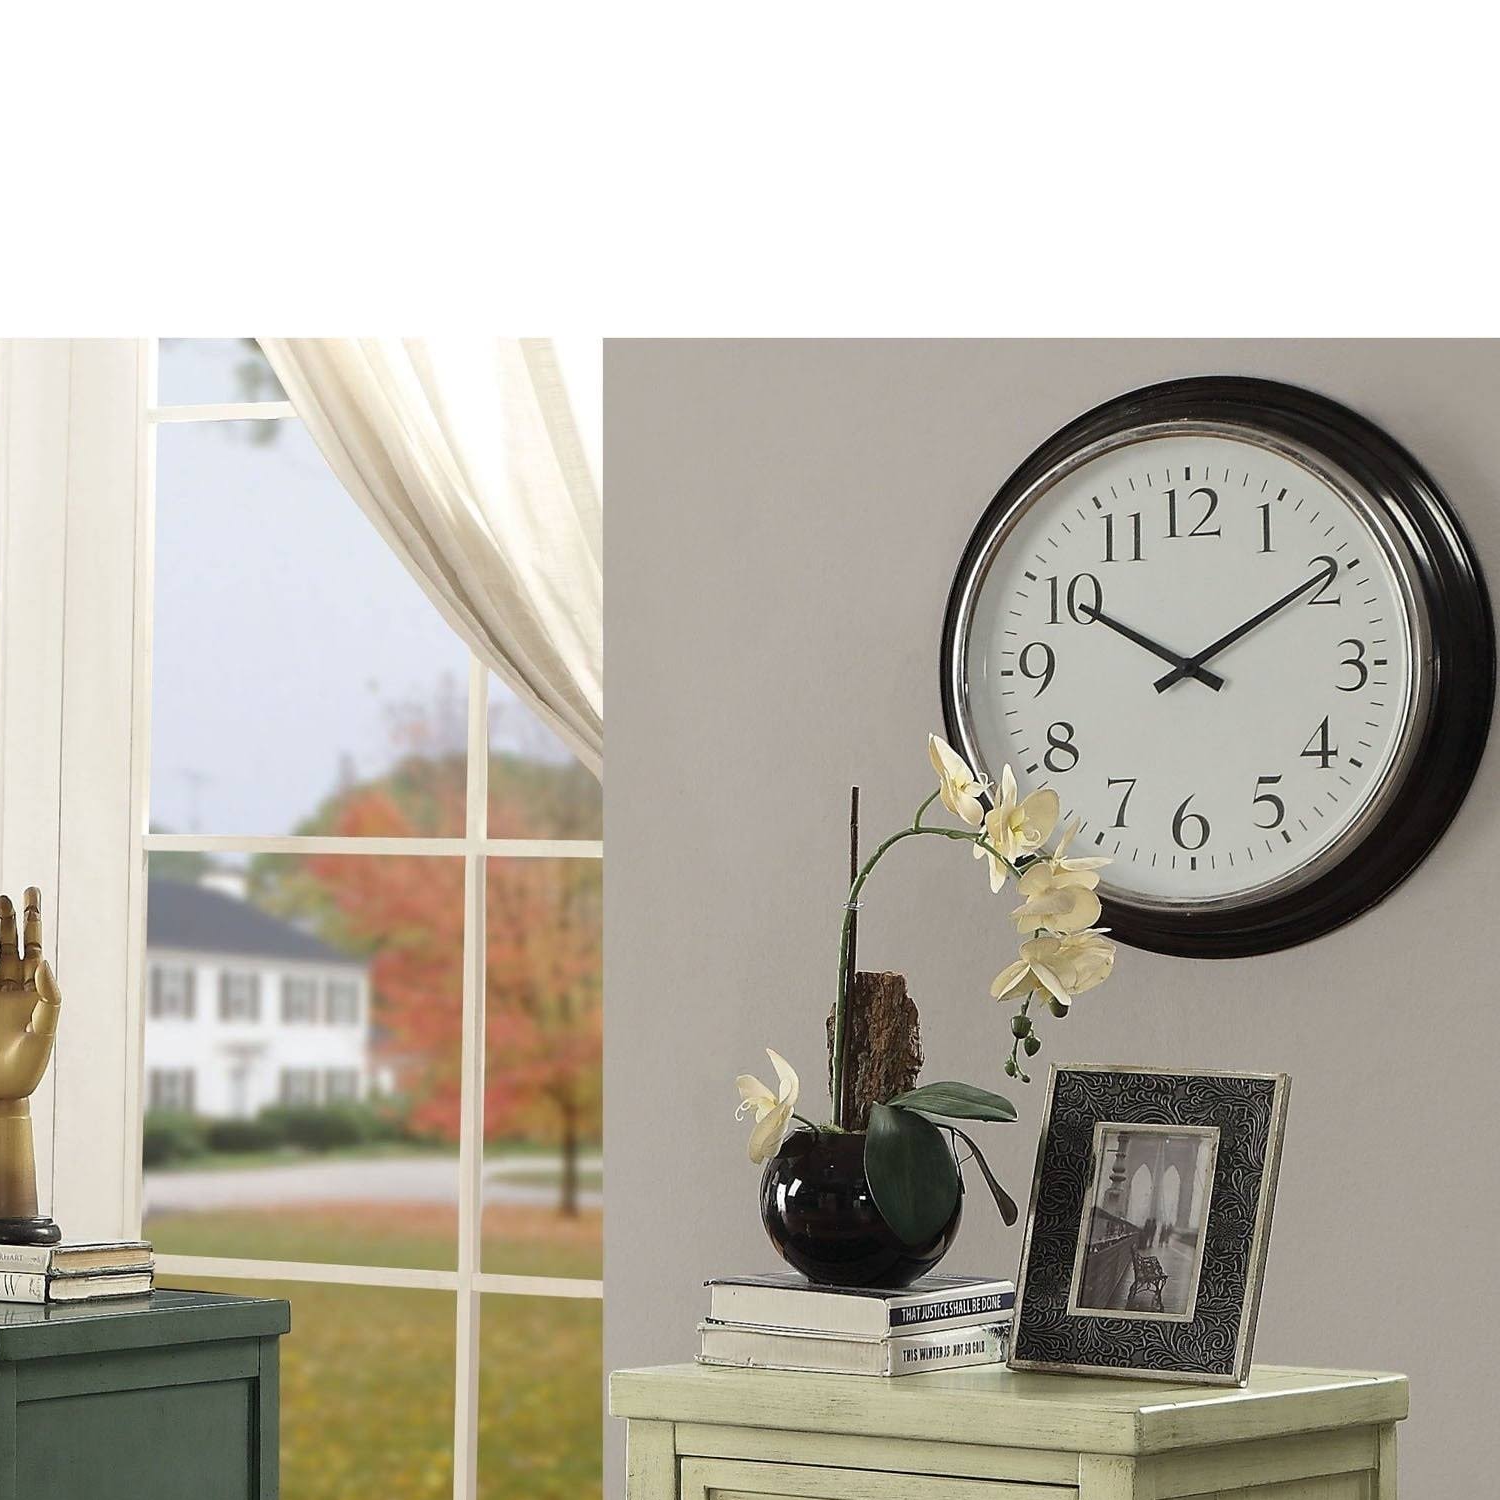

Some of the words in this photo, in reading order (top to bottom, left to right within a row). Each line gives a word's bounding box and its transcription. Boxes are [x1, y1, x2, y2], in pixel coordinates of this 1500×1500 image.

[1100, 512, 1147, 562] 11
[1162, 487, 1222, 538] 12
[1256, 502, 1275, 552] 1
[1045, 572, 1104, 625] 10
[1307, 555, 1341, 605] 2
[1019, 642, 1056, 698] 9
[1335, 639, 1368, 692] 3
[1043, 721, 1079, 773] 8
[1300, 714, 1338, 769] 4
[1107, 777, 1137, 828] 7
[1171, 794, 1210, 850] 6
[1252, 775, 1285, 829] 5
[902, 1307, 921, 1322] THAT
[921, 1303, 948, 1320] JUSTICE
[949, 1299, 971, 1316] SHALL
[972, 1298, 981, 1312] BE
[981, 1295, 1001, 1311] DONE
[903, 1348, 918, 1362] THIS
[919, 1346, 944, 1361] WINTER
[944, 1344, 951, 1358] IS
[952, 1343, 964, 1357] NOT
[965, 1342, 971, 1355] SO
[972, 1340, 985, 1354] COLD
